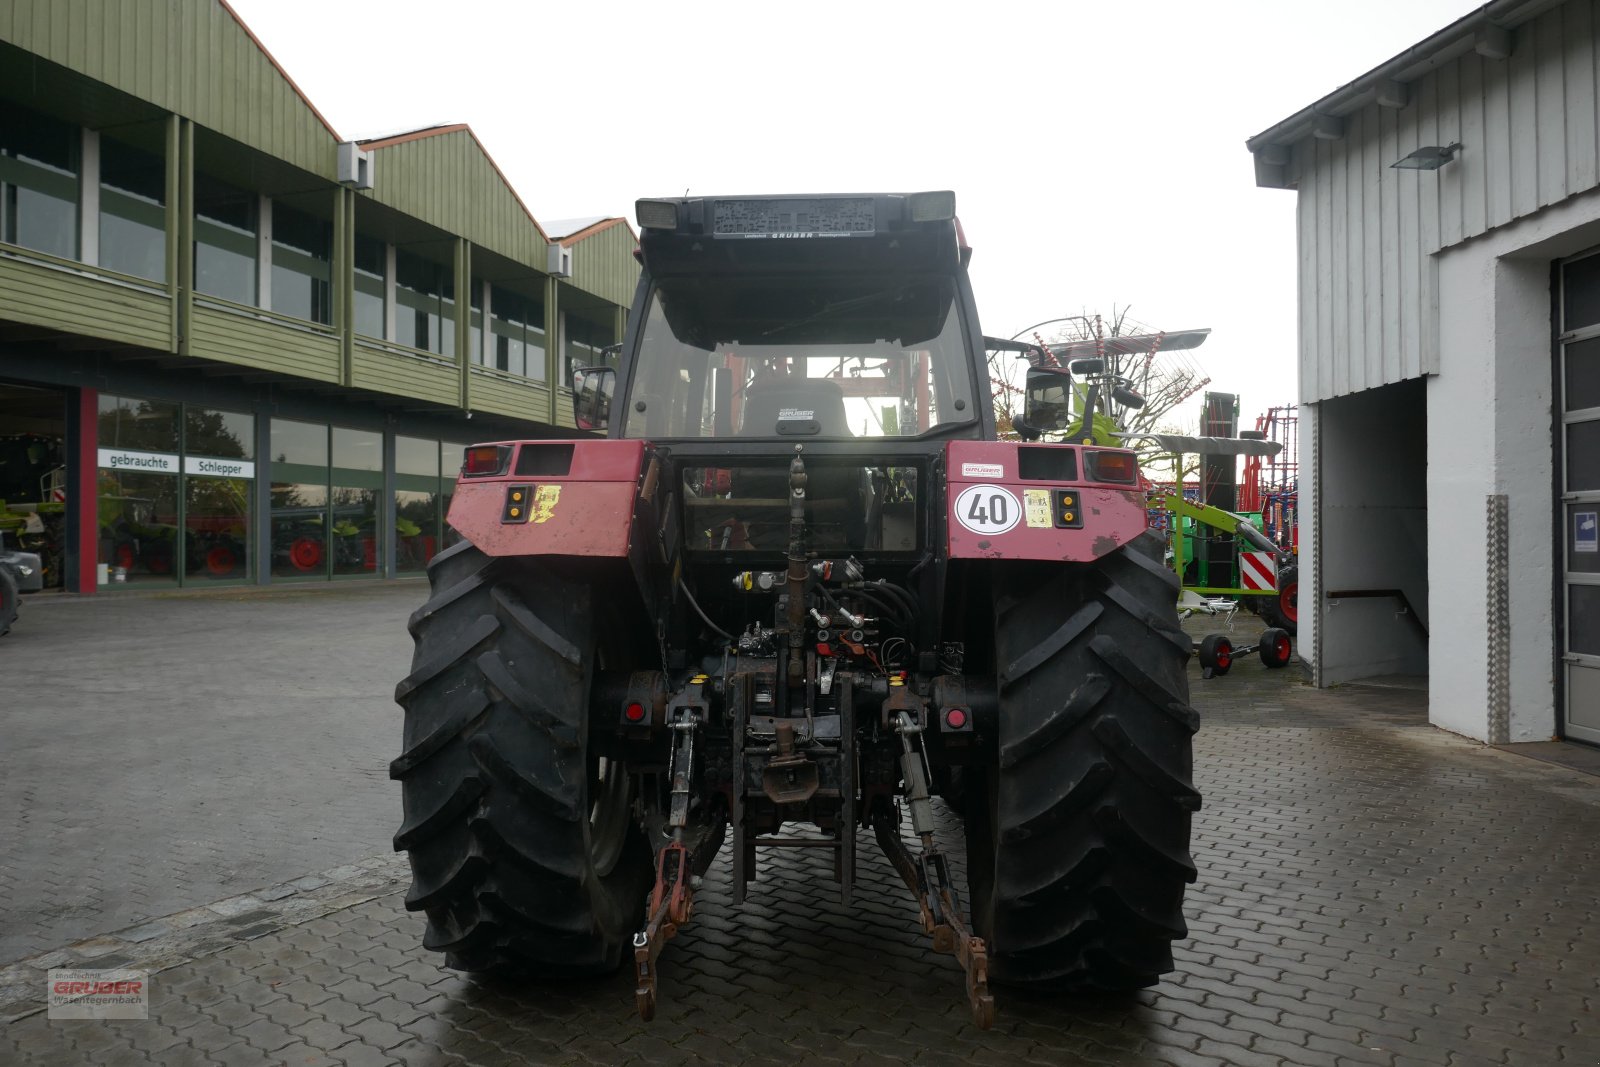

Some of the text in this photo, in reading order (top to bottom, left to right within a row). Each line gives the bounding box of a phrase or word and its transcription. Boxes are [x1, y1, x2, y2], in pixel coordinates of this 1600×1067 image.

[110, 454, 242, 476] gebrauchte Schlepper
[968, 494, 1008, 525] 40
